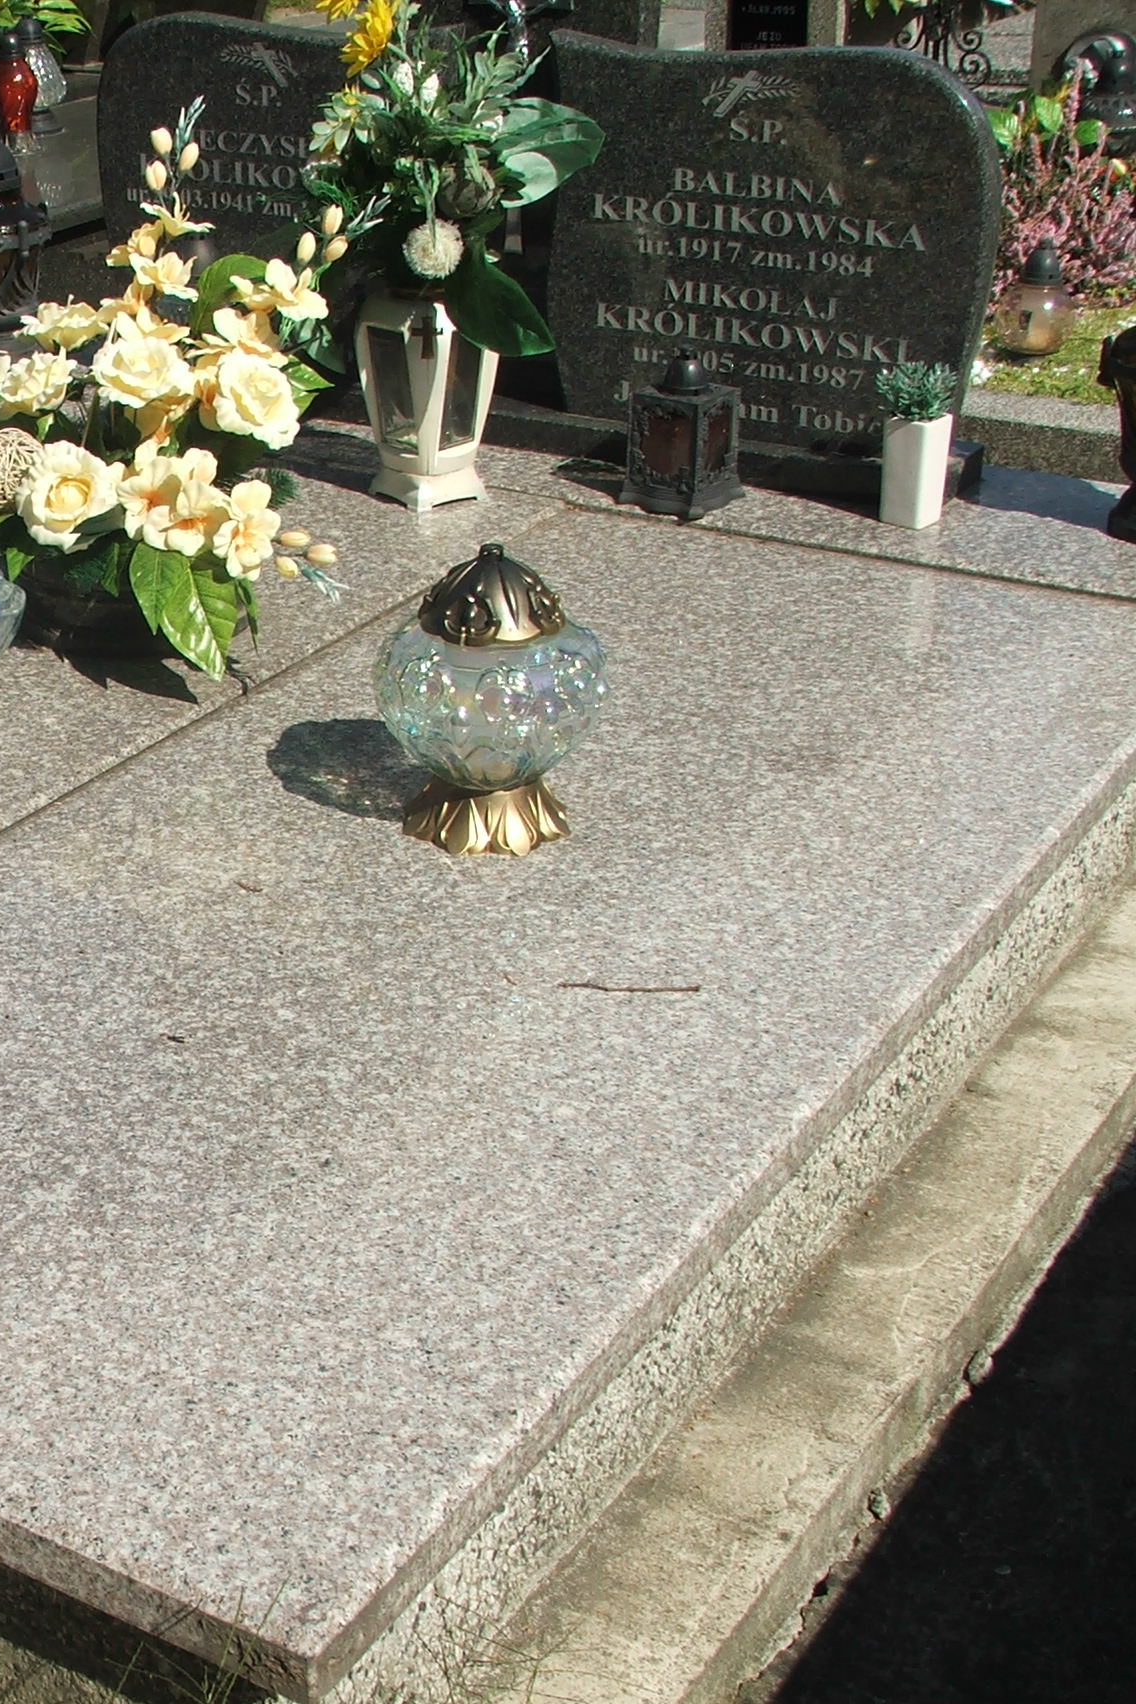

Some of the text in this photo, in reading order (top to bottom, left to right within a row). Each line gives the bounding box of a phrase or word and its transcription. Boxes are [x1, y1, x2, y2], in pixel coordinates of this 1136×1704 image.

[729, 110, 788, 145] Ś.P.
[672, 167, 843, 207] BALBINA
[593, 192, 926, 252] KRÓLIKOWSKA
[637, 236, 874, 278] ur.1917 zm.1984
[663, 278, 840, 322] MIKOŁAJ
[595, 301, 912, 365] KRÓLIKOWSKI
[744, 360, 865, 391] zm.1987
